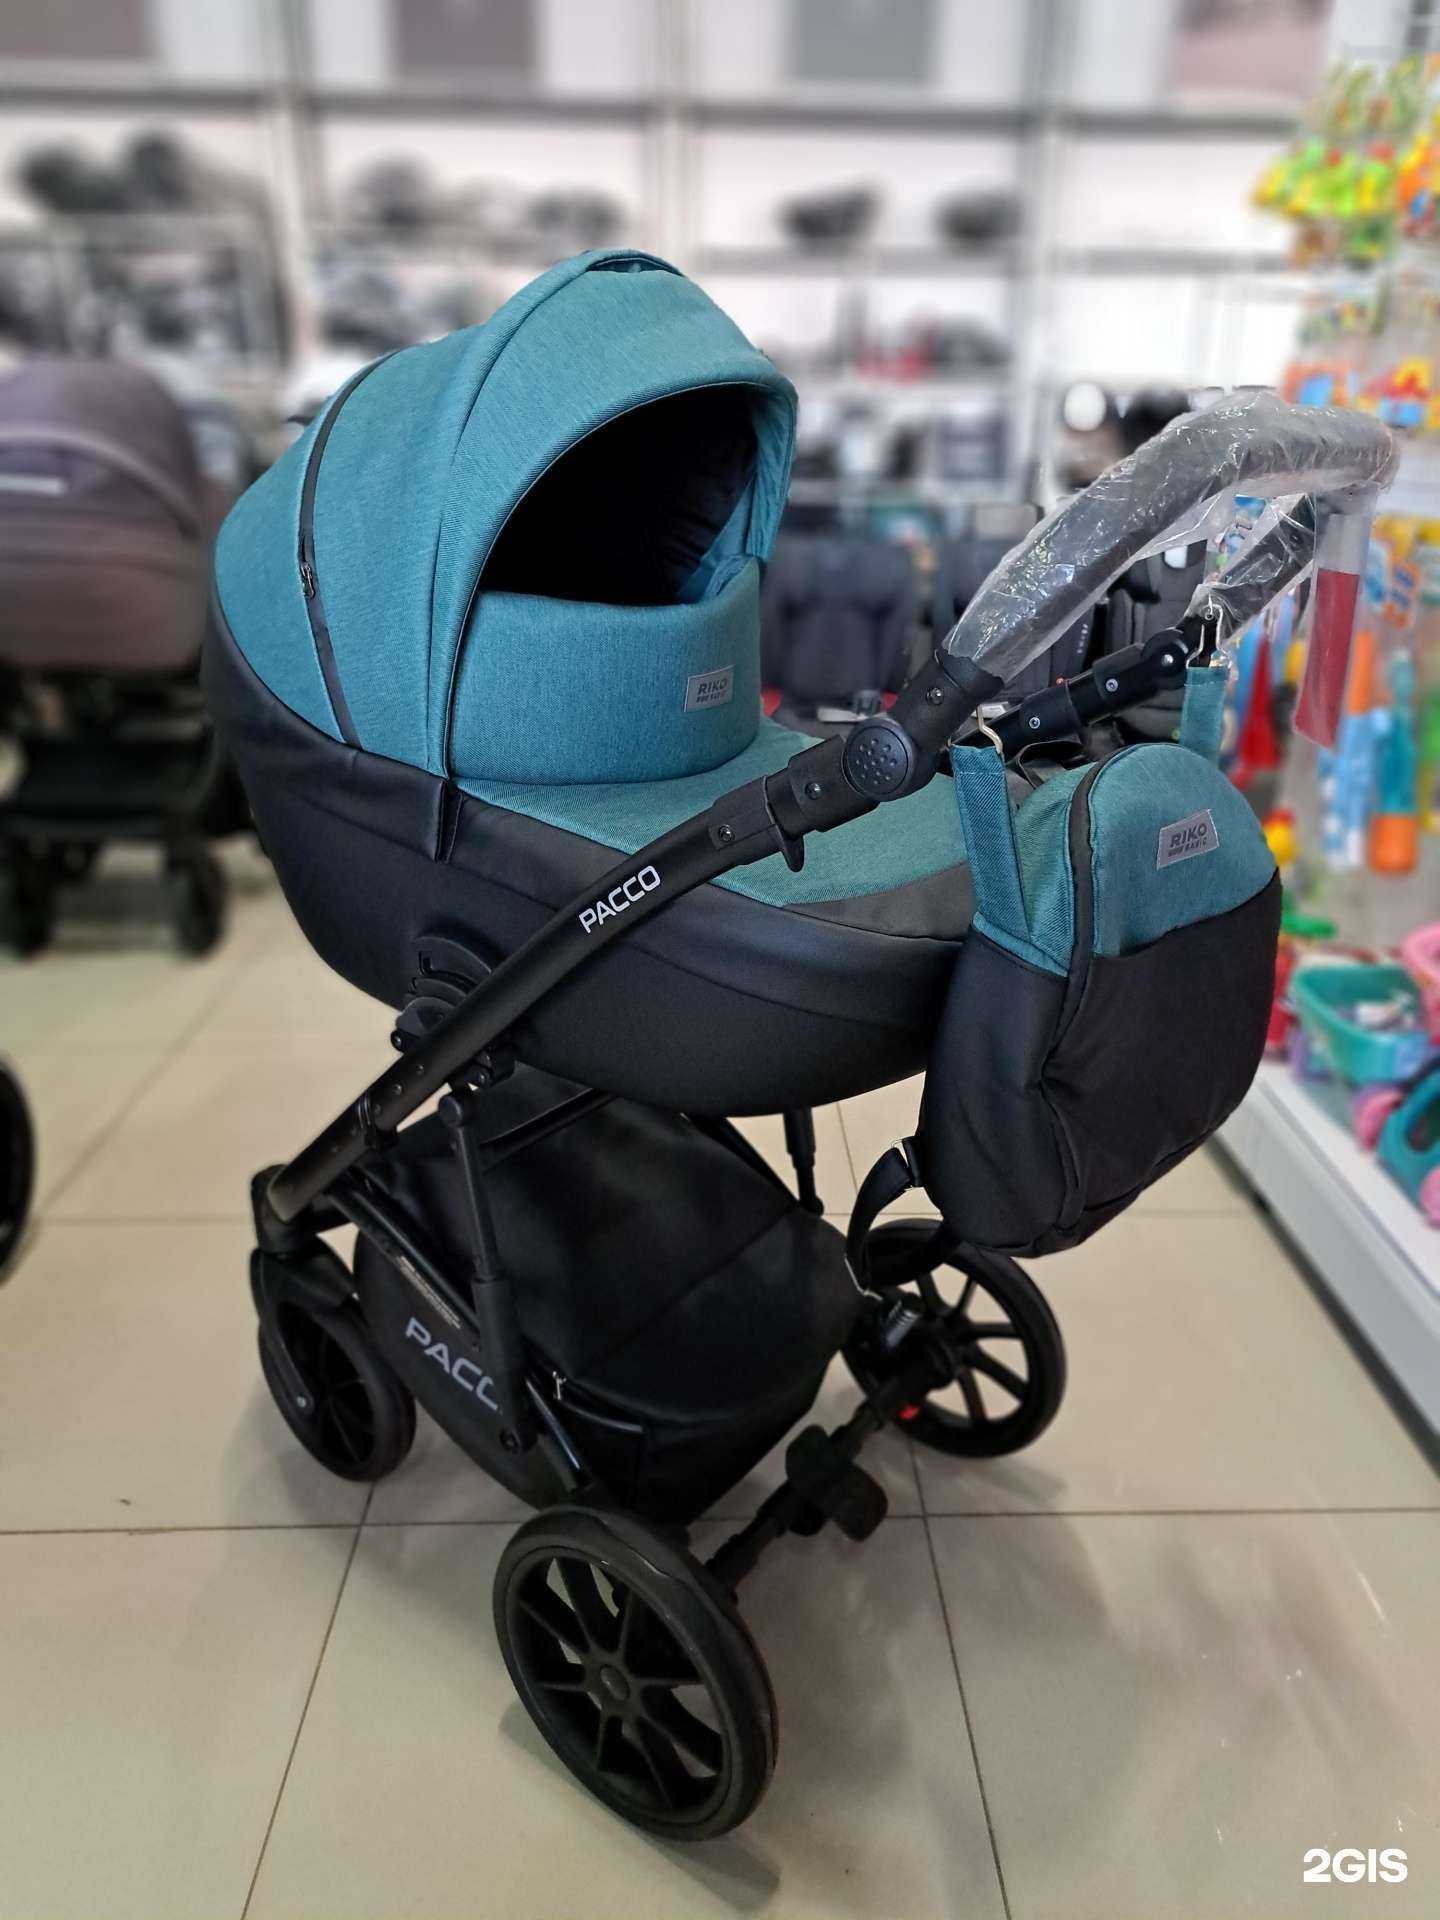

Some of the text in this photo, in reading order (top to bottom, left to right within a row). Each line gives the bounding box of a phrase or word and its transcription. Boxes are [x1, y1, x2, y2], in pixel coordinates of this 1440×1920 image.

[698, 678, 728, 695] RIKO
[1170, 823, 1208, 848] RIKO
[579, 865, 661, 934] PACCO
[405, 1316, 499, 1411] PACC
